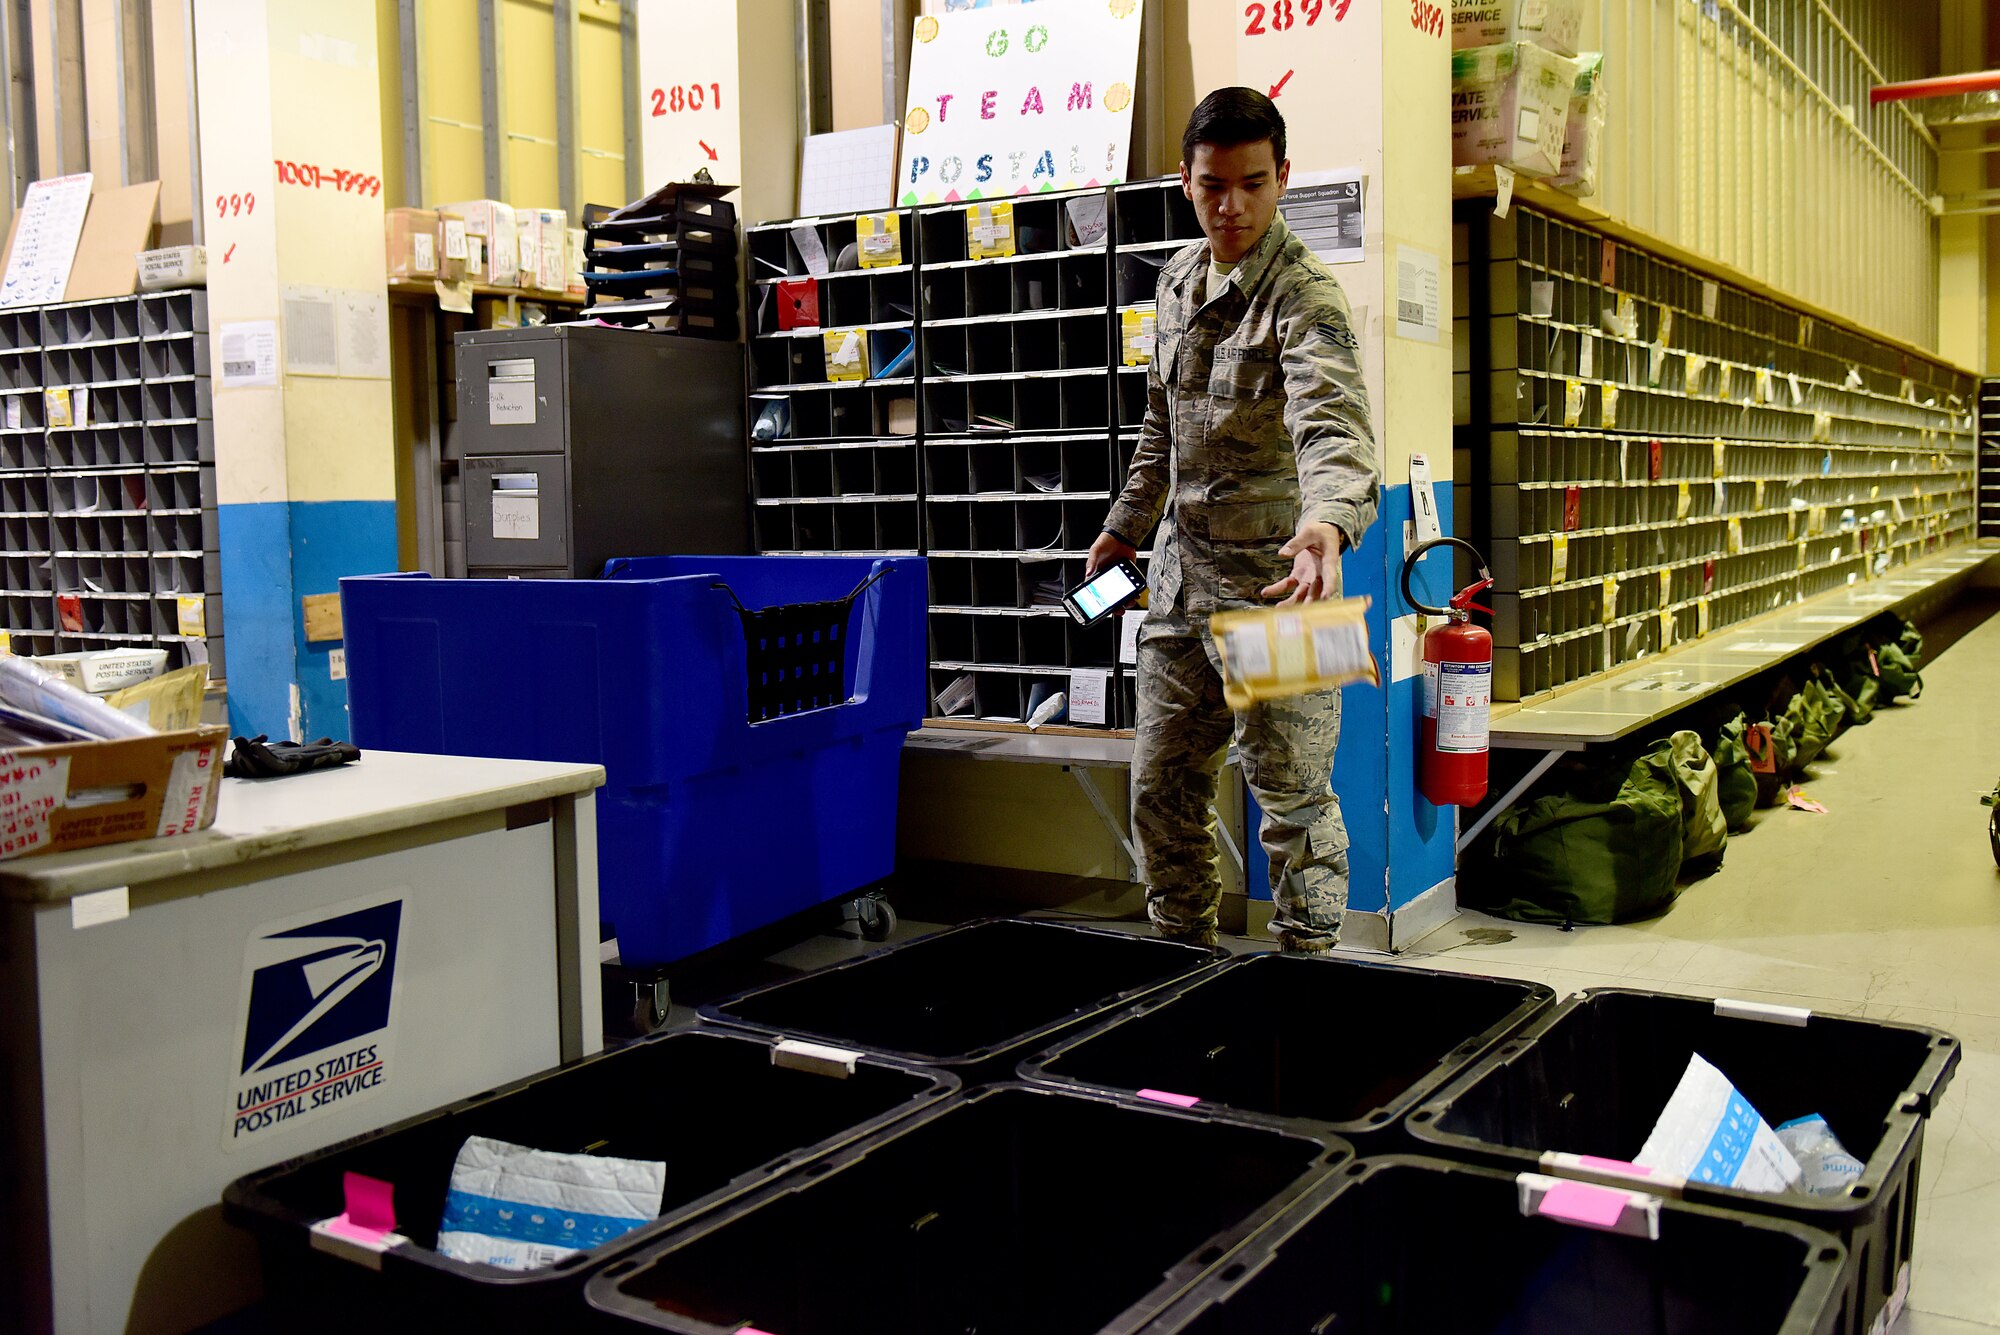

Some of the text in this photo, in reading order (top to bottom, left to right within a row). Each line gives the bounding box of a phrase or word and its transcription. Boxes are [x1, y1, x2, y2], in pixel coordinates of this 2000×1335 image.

[1451, 8, 1501, 25] SERVICE
[985, 24, 1049, 58] GO
[651, 83, 721, 118] 2801
[936, 80, 1093, 123] TEAM
[1452, 106, 1500, 124] ERVICE
[910, 142, 1116, 185] POSTAL!
[273, 159, 382, 198] 1001-1999
[216, 191, 256, 219] 999
[1299, 191, 1318, 199] Support
[1317, 189, 1340, 197] Squadron
[162, 252, 181, 260] STATES
[494, 505, 531, 526] Supplies
[95, 667, 154, 679] POSTAL SERVICE
[98, 659, 152, 671] UNITED STATES
[236, 1043, 378, 1111] UNITED STATES
[233, 1065, 384, 1139] POSTAL SERVICE
